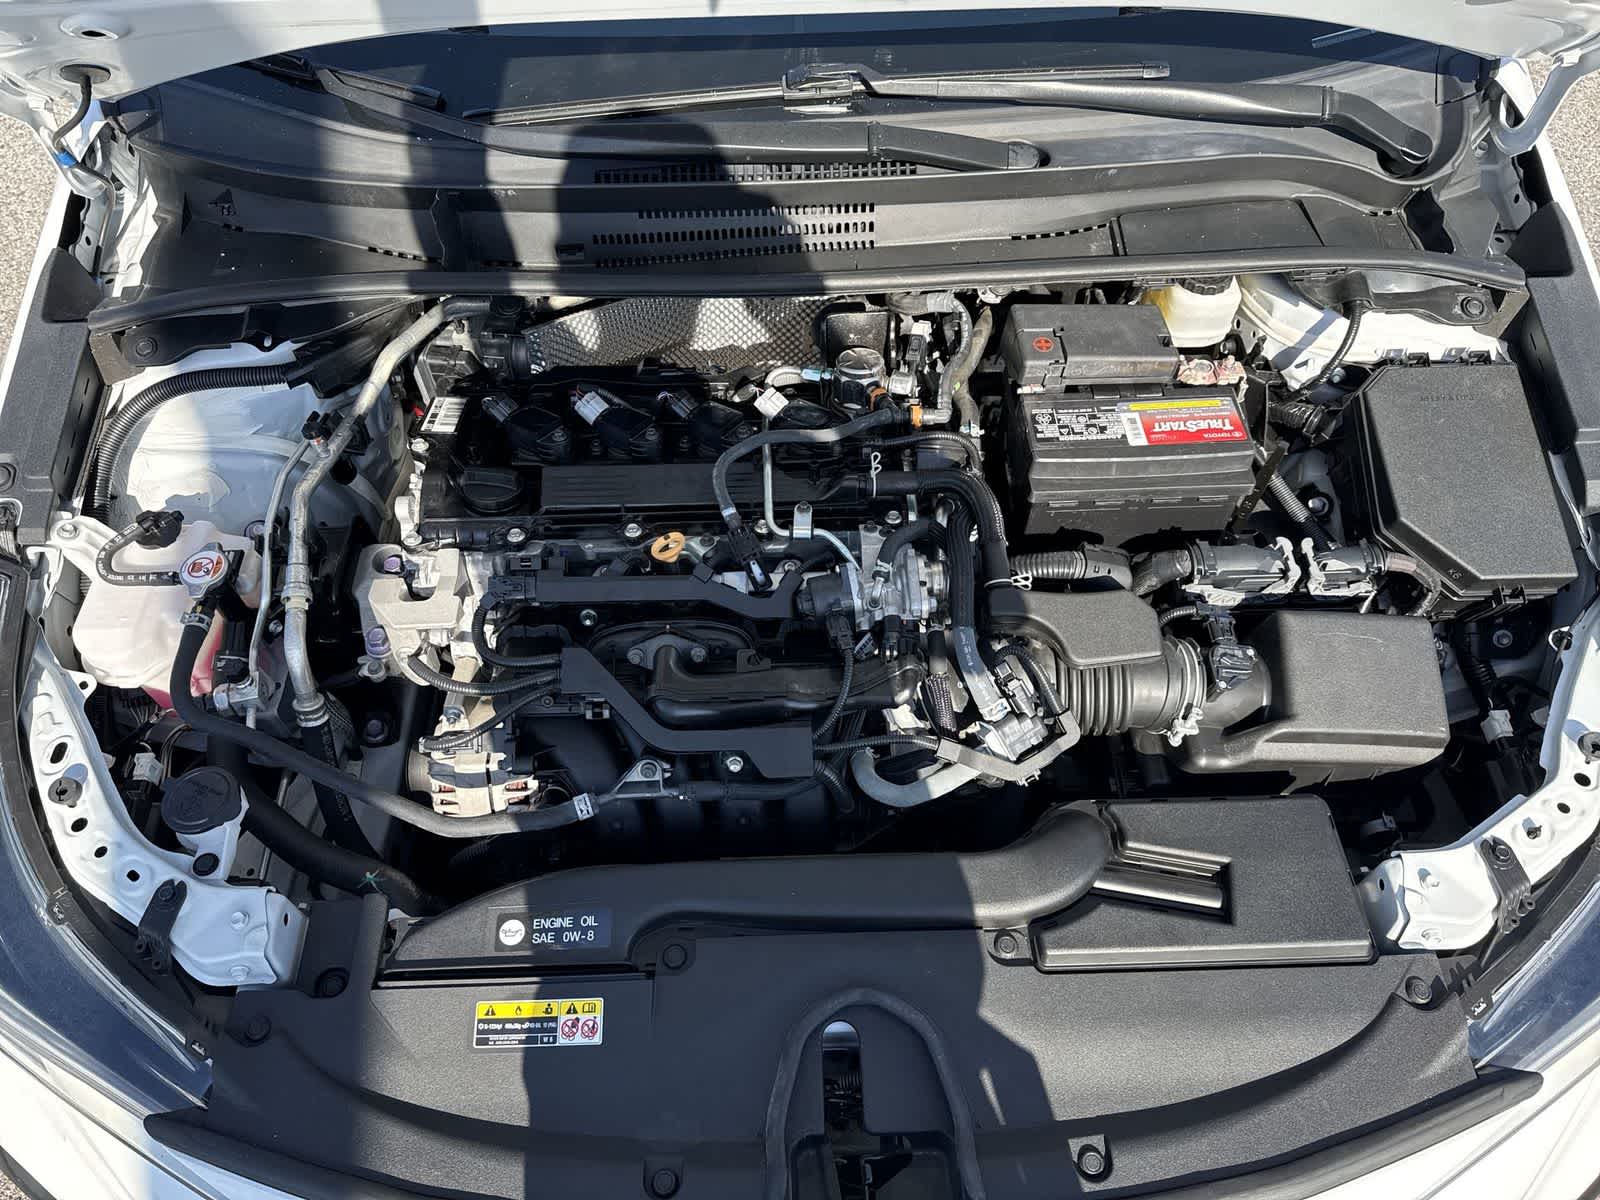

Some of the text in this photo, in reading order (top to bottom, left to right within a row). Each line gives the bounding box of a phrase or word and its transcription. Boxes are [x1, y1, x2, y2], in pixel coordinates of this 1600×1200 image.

[533, 915, 599, 930] ENGINE OIL
[532, 930, 595, 944] SAE 0W-8
